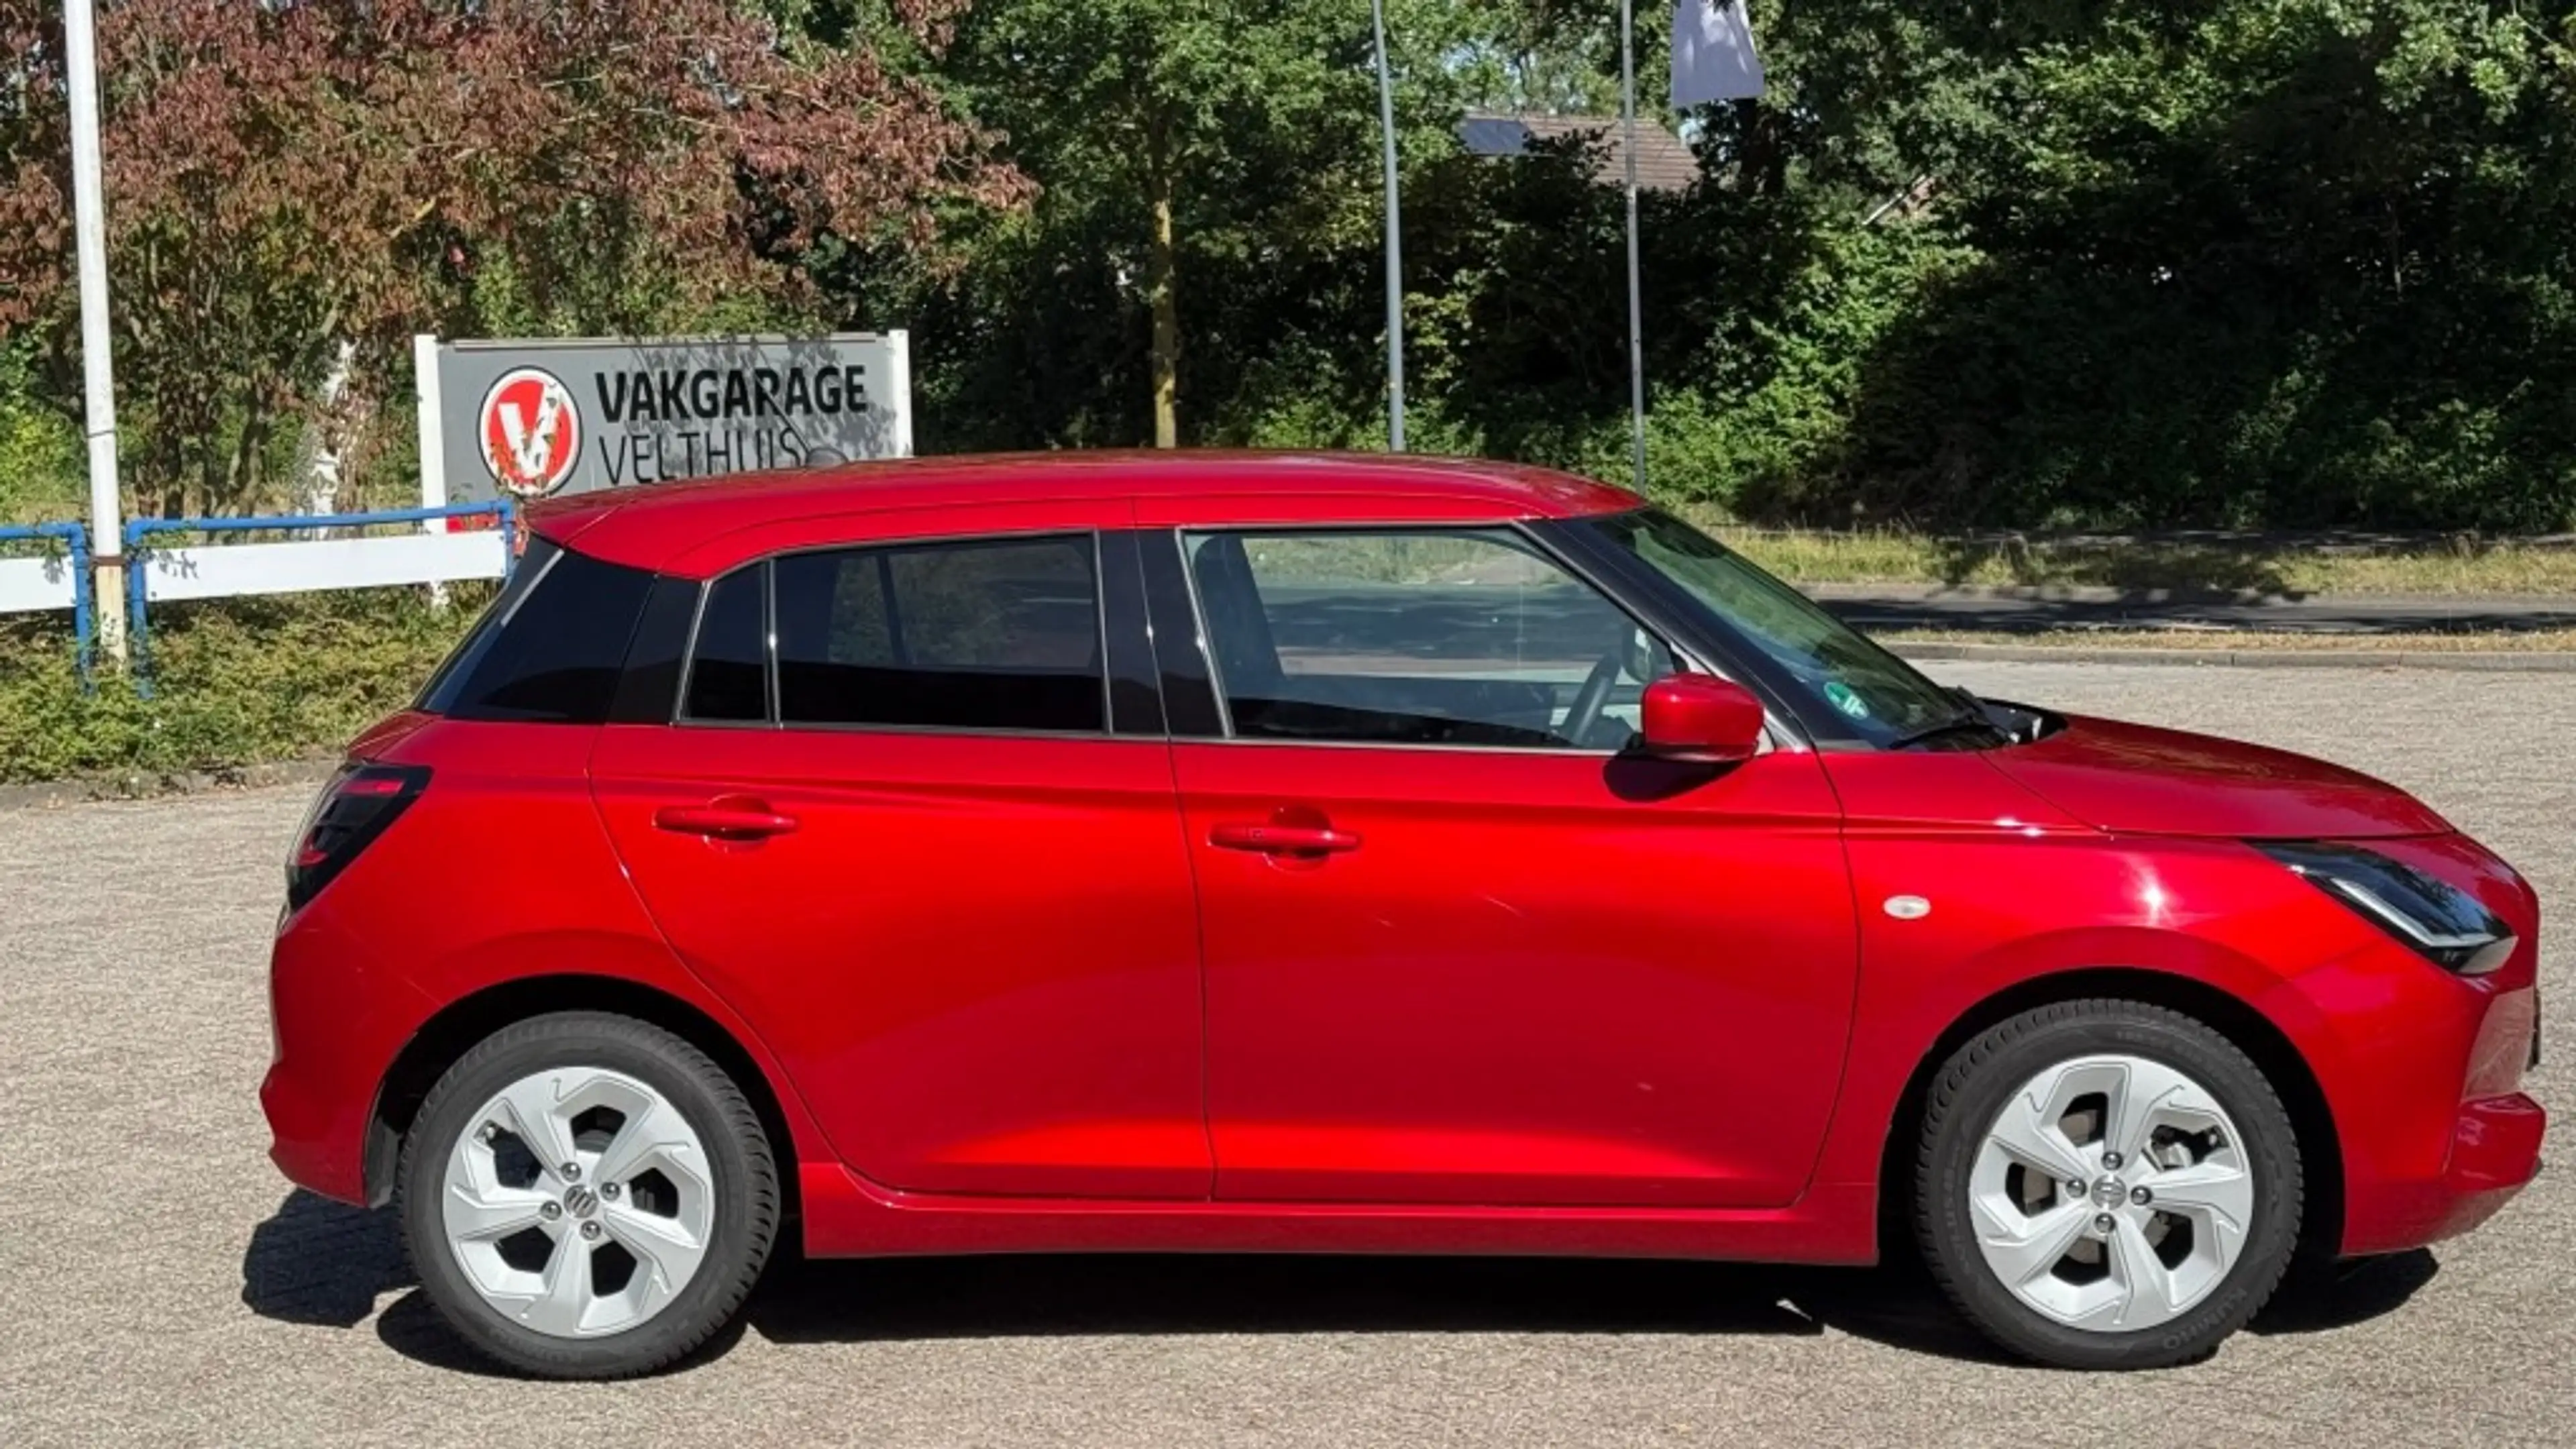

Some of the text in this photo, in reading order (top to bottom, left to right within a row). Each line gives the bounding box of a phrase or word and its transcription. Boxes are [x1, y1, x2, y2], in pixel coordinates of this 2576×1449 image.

[595, 365, 869, 423] VAKGARAGE
[498, 382, 562, 479] V
[598, 426, 802, 486] VELTHUIS
